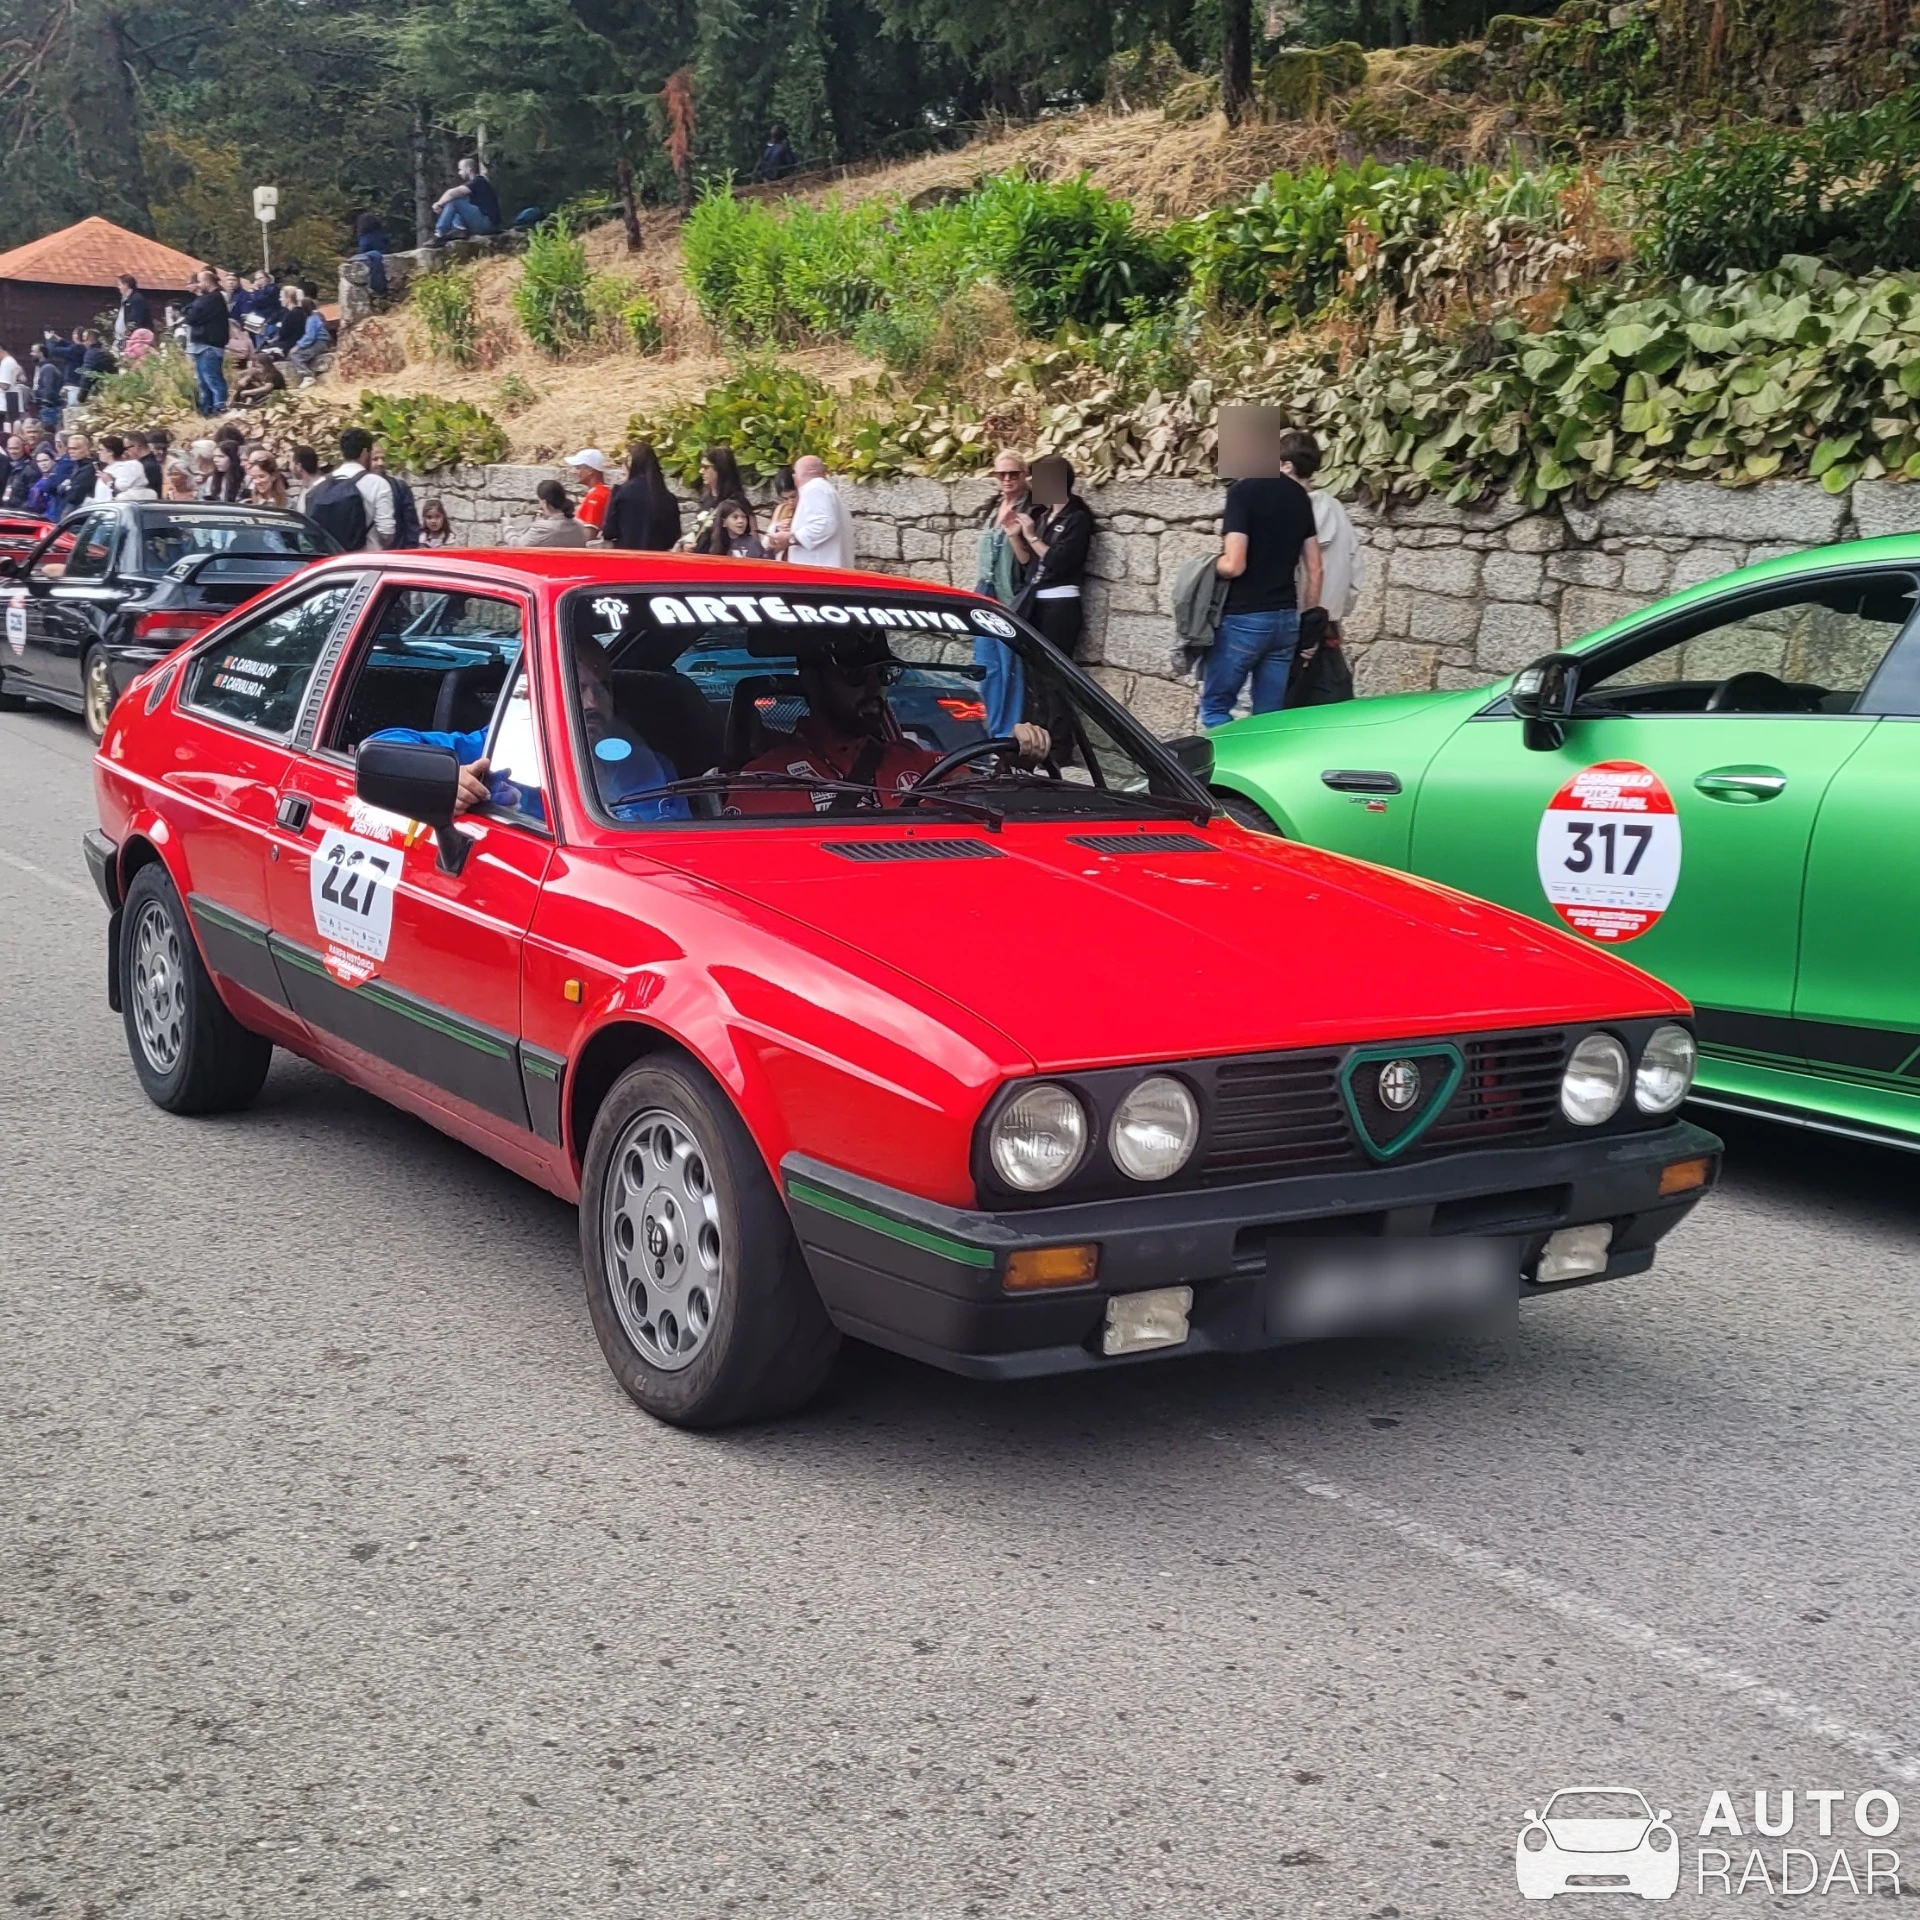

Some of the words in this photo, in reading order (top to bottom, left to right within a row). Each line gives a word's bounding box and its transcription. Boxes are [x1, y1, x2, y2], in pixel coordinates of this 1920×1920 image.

[236, 658, 269, 678] CARVALHO
[226, 676, 258, 696] CARVALHO
[1581, 797, 1648, 810] FESTIVAL
[1563, 821, 1654, 876] 317
[322, 844, 390, 917] 227
